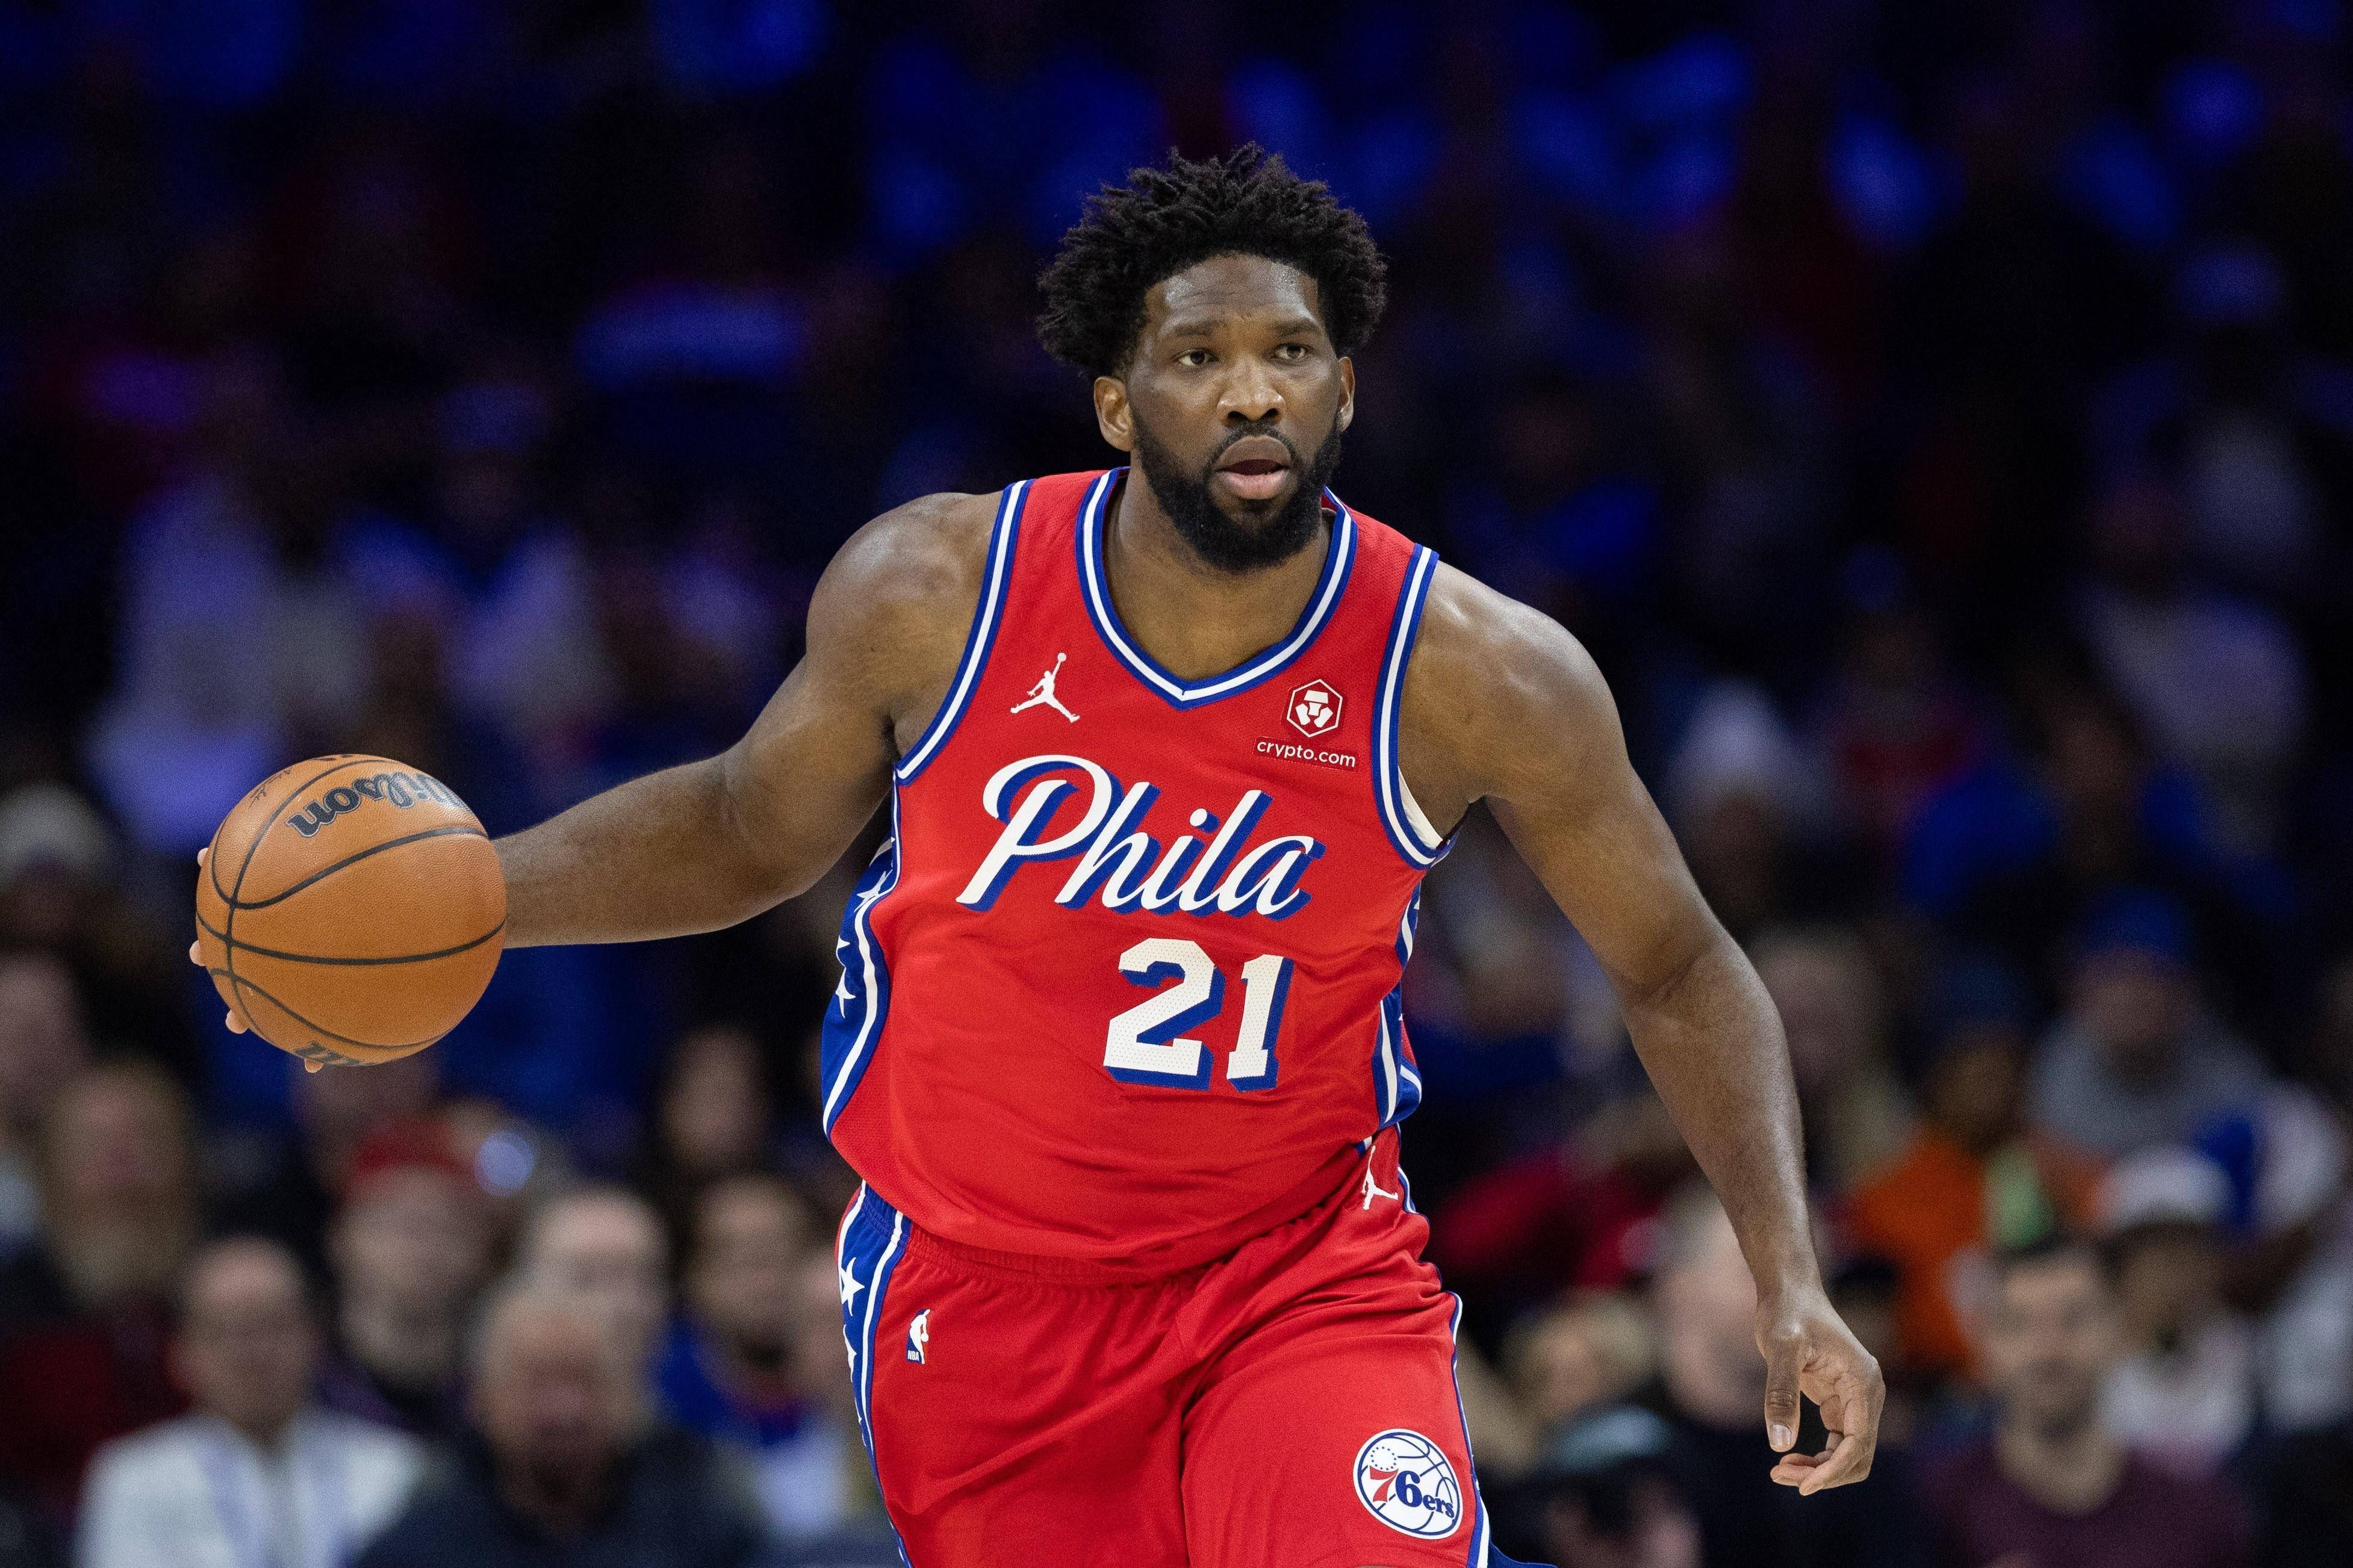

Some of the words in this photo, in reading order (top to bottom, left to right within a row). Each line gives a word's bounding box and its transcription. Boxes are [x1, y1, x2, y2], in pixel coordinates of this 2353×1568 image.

[1257, 741, 1356, 767] crypto.com
[955, 754, 1326, 921] Phila
[1103, 937, 1295, 1091] 21
[907, 1350, 919, 1361] NBA
[1369, 1465, 1455, 1518] 76ers
